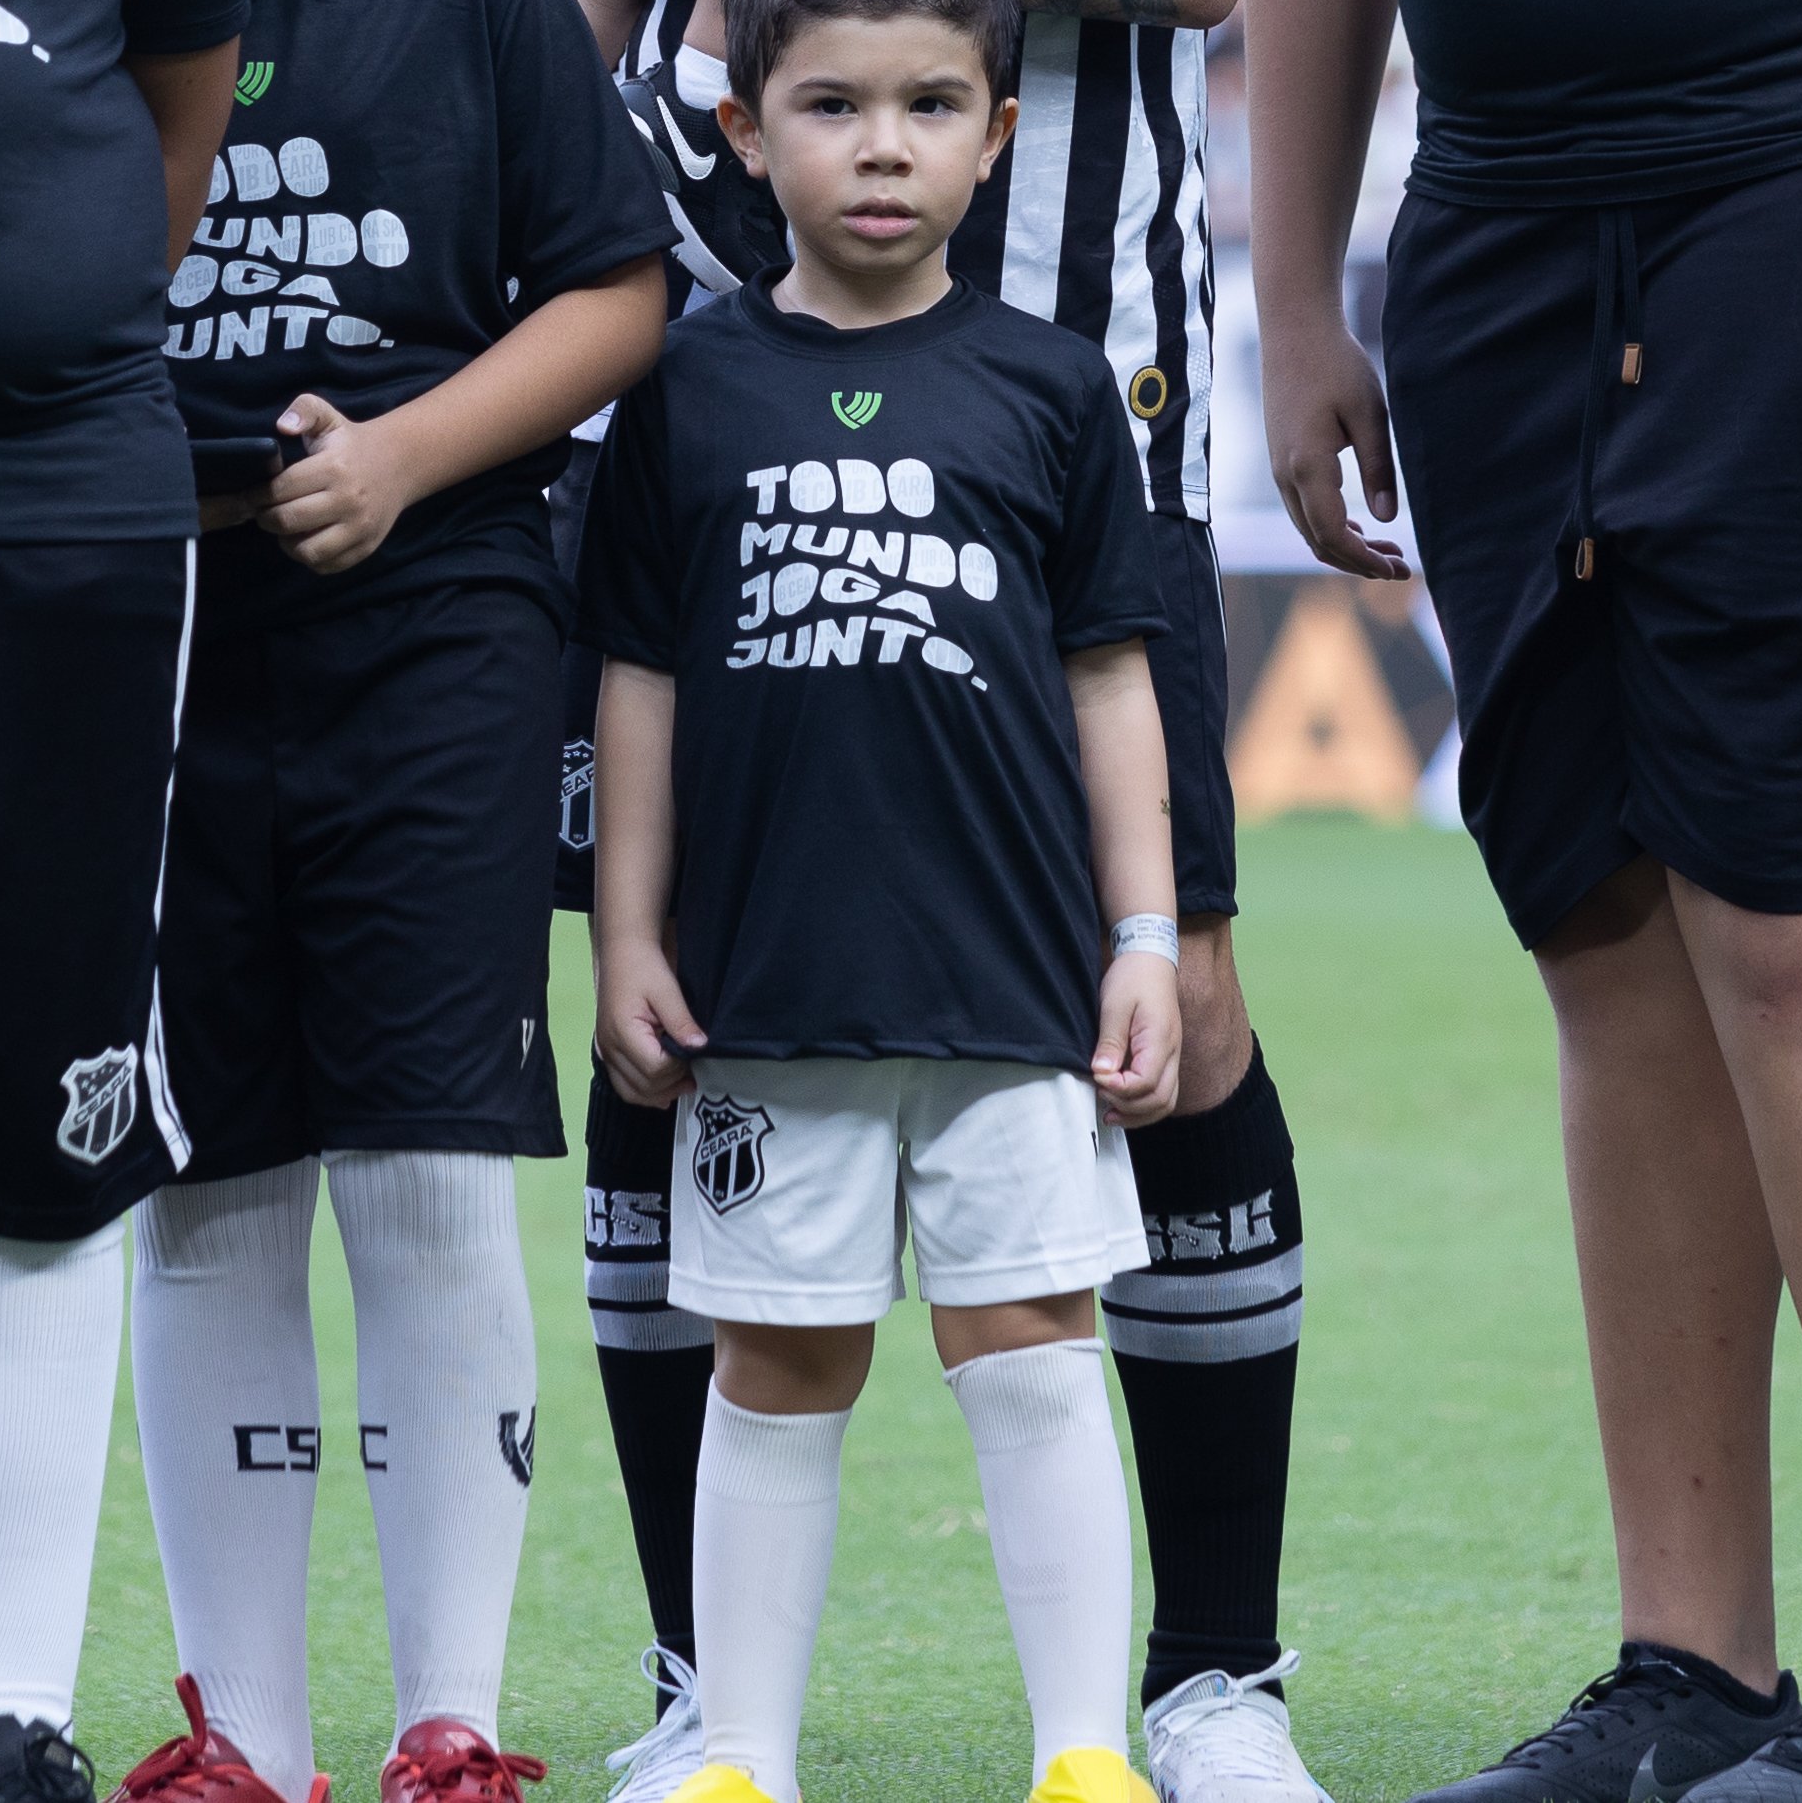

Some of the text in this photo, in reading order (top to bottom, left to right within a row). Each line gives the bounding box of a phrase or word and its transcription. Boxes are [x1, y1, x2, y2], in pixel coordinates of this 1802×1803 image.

[746, 458, 935, 518] TODO
[739, 521, 998, 602] MUNDO
[737, 562, 937, 631] JOGA
